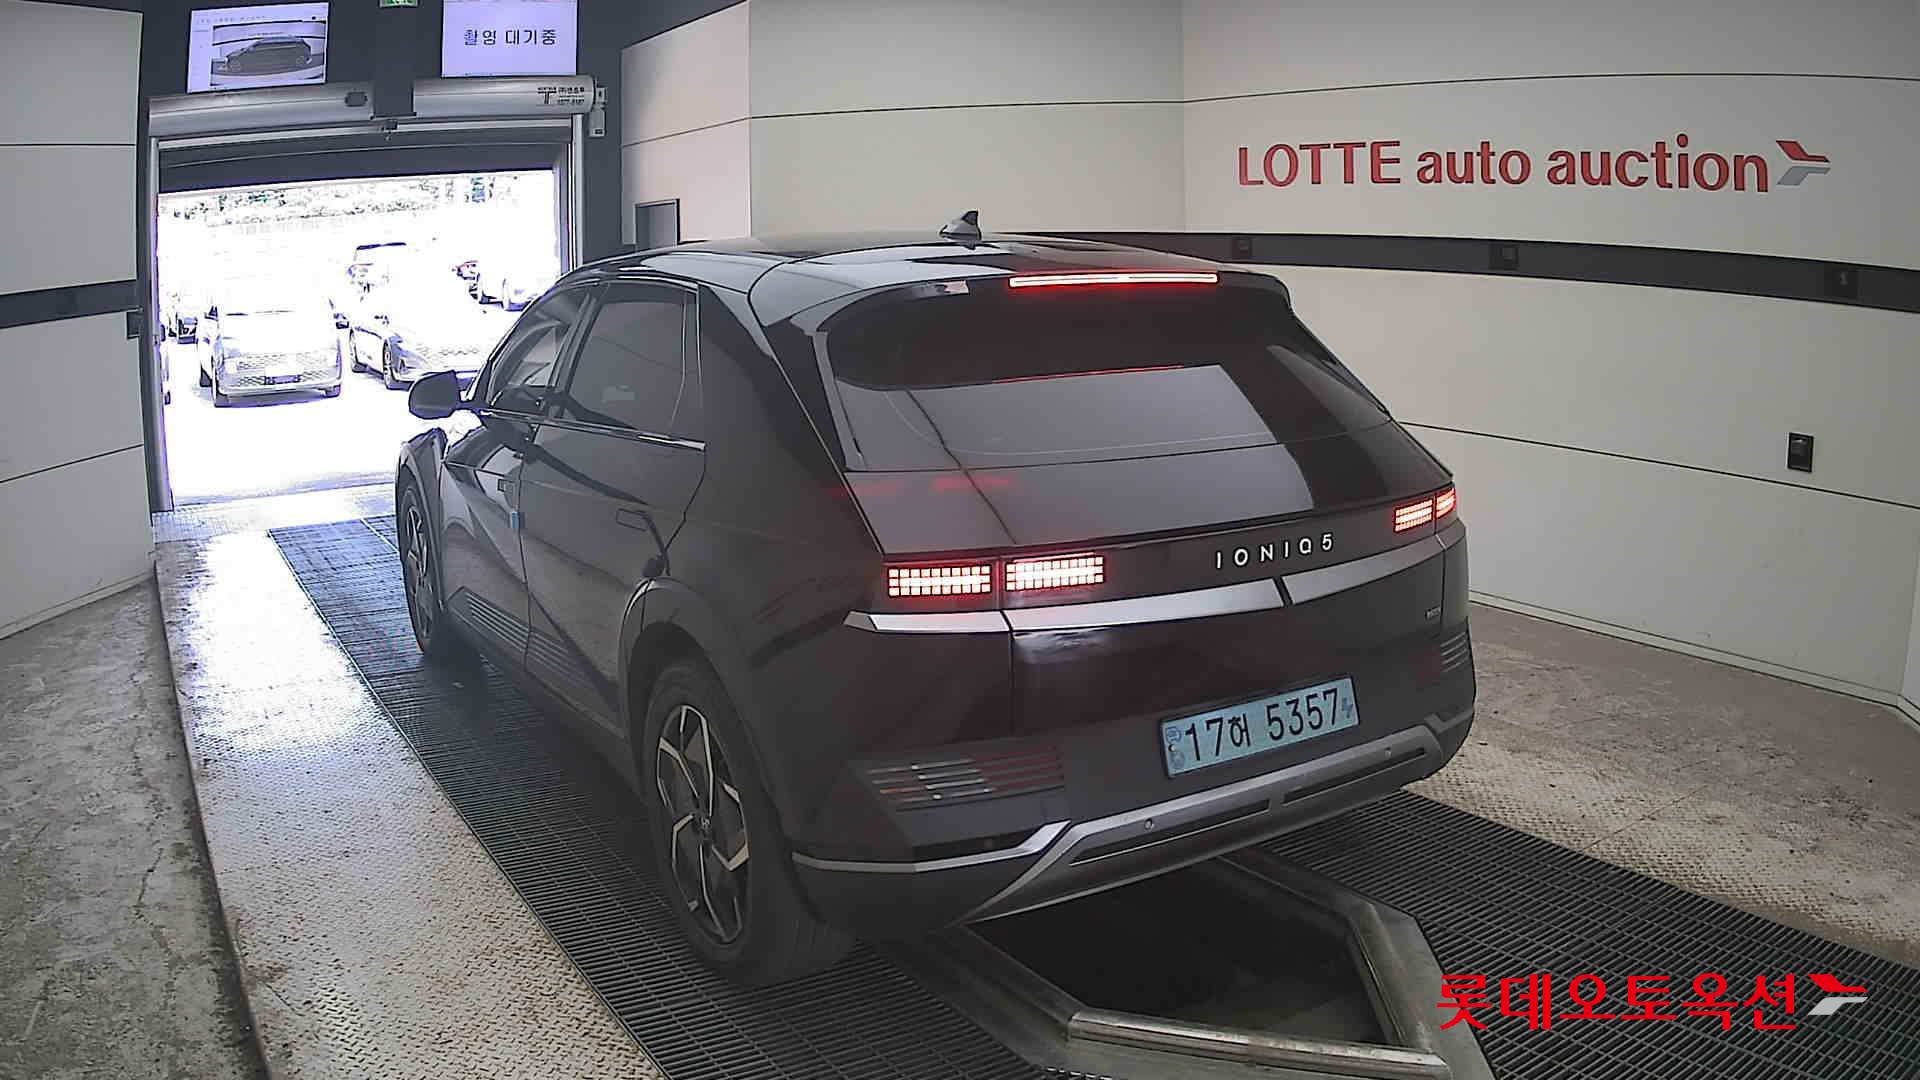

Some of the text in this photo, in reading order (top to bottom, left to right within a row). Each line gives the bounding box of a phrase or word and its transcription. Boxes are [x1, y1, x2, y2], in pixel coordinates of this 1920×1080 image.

[505, 29, 557, 46] 대기중
[1239, 133, 1769, 192] LOTTE auto auction
[1185, 688, 1338, 761] 17허 5357
